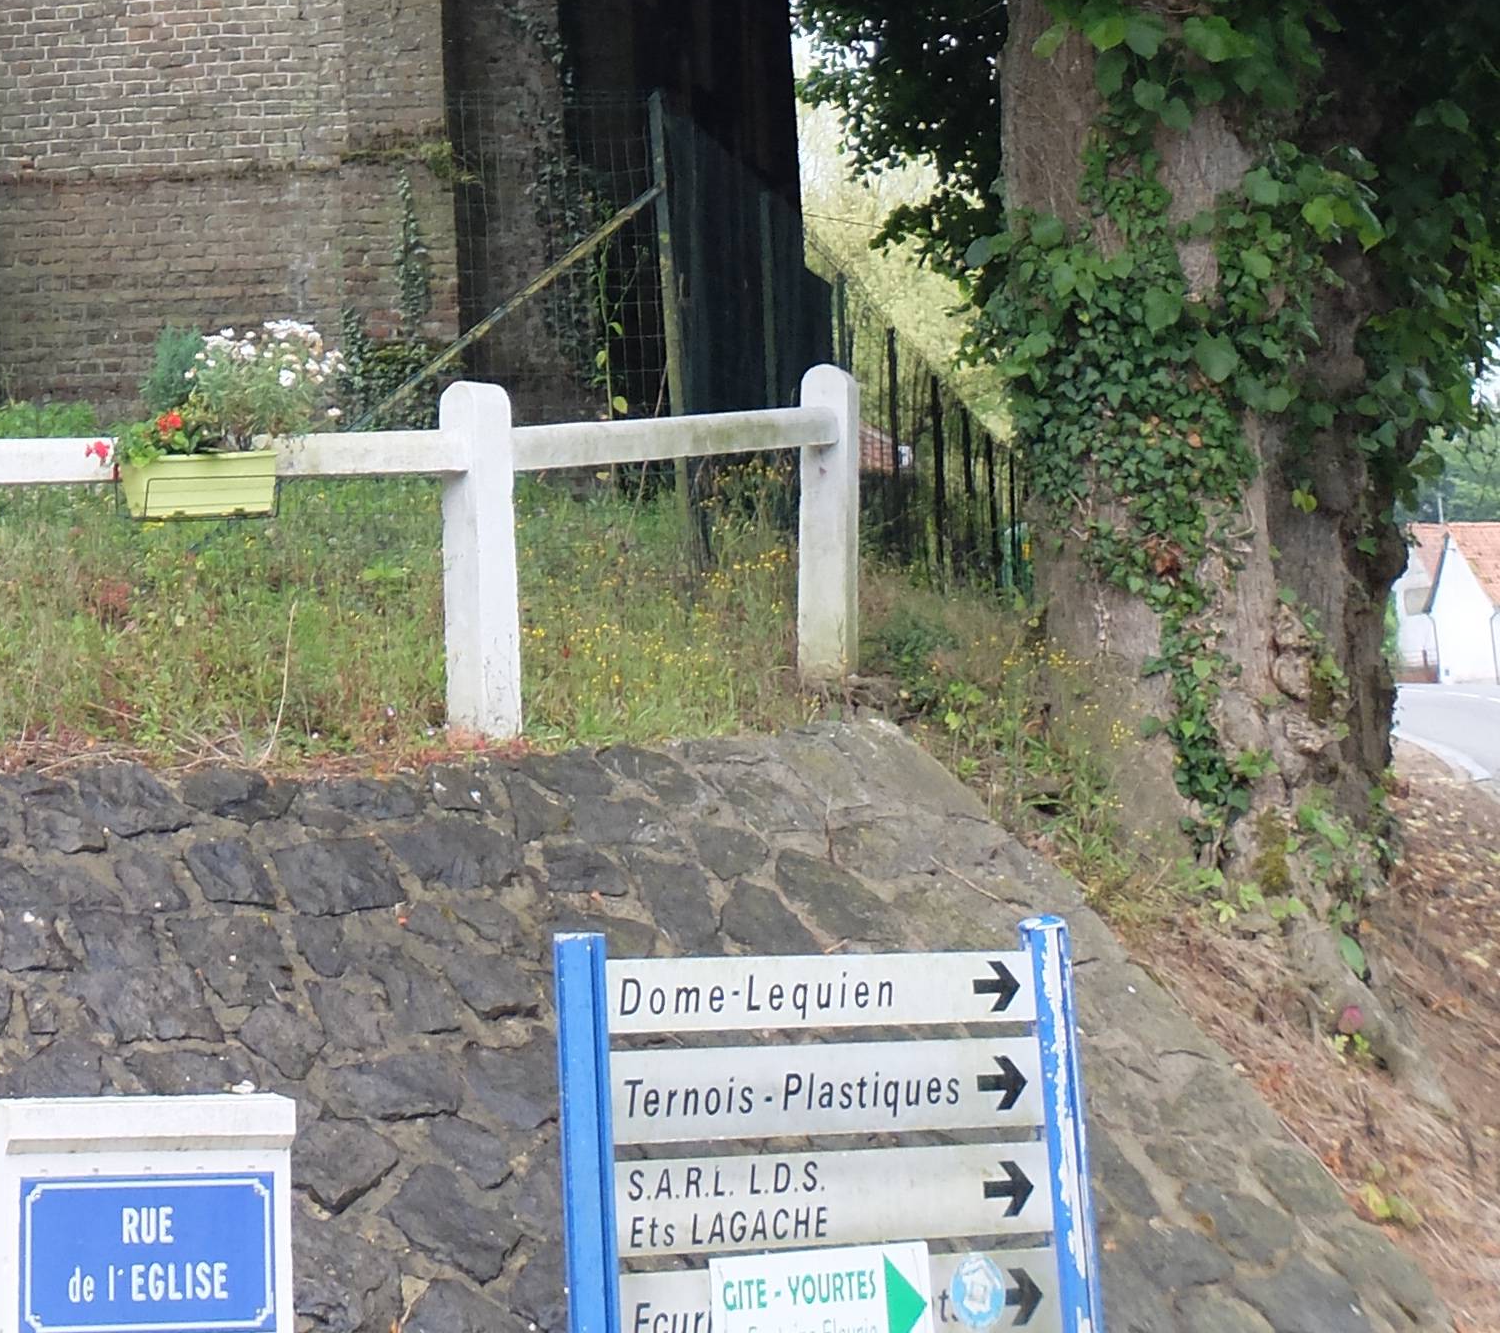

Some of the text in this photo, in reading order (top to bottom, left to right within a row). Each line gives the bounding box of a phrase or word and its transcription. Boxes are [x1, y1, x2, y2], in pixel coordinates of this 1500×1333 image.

[619, 972, 894, 1020] Dome-Lequien
[628, 1160, 826, 1201] S.A.R.L. L.D.S.
[122, 1206, 175, 1244] RUE
[630, 1206, 828, 1248] Ets LAGACHE
[68, 1267, 95, 1303] de
[722, 1278, 768, 1311] GITE
[788, 1268, 877, 1305] YOURTES
